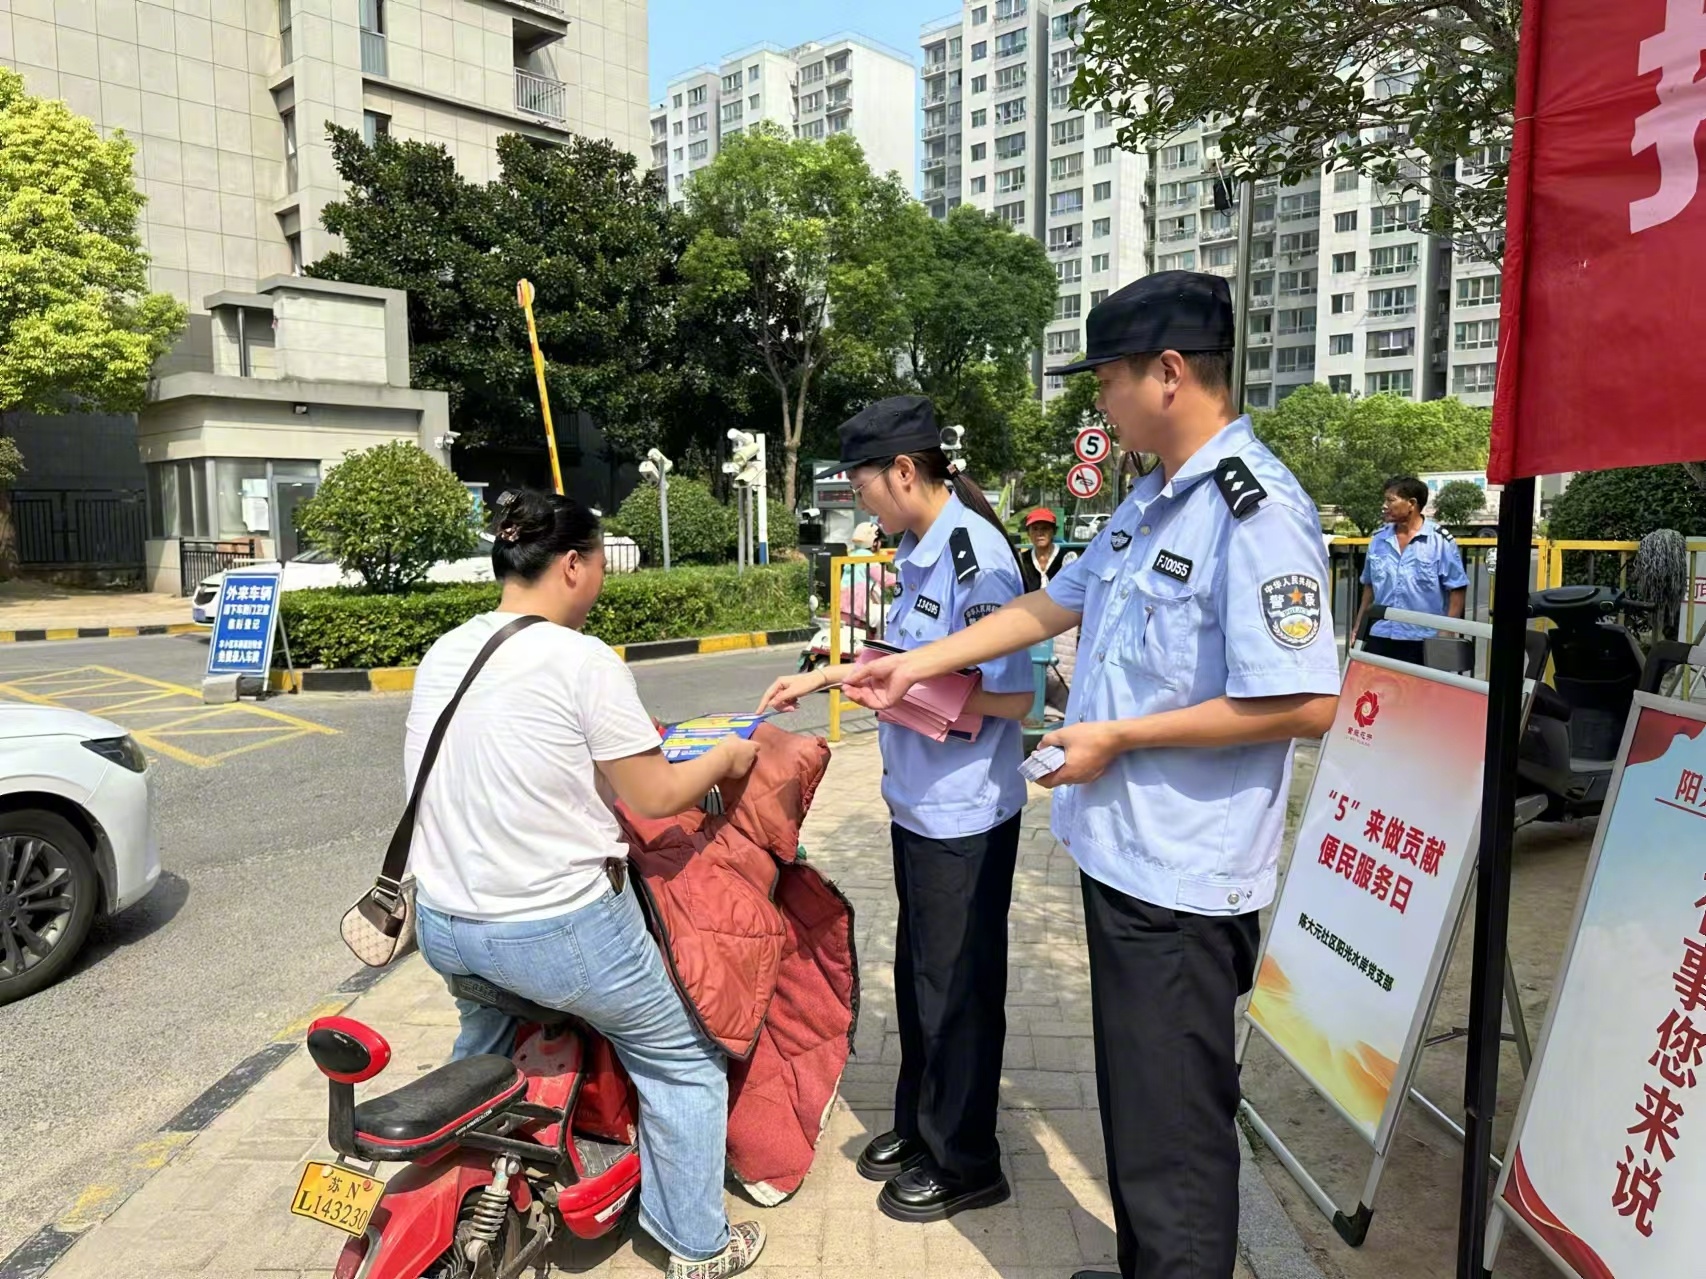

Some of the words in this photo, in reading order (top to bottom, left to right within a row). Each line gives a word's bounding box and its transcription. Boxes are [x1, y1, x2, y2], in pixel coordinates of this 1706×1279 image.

[1085, 435, 1100, 456] 5
[1156, 554, 1190, 577] FJ0055
[225, 585, 273, 601] 外来车辆
[1675, 768, 1706, 808] 阳
[1318, 833, 1414, 915] 便民服务日
[1298, 912, 1394, 992] 陈大元社区阳光水岸党支部
[1612, 873, 1706, 1238] 事您来说
[327, 1176, 343, 1193] 苏
[345, 1181, 361, 1200] N
[296, 1190, 369, 1230] L143230
